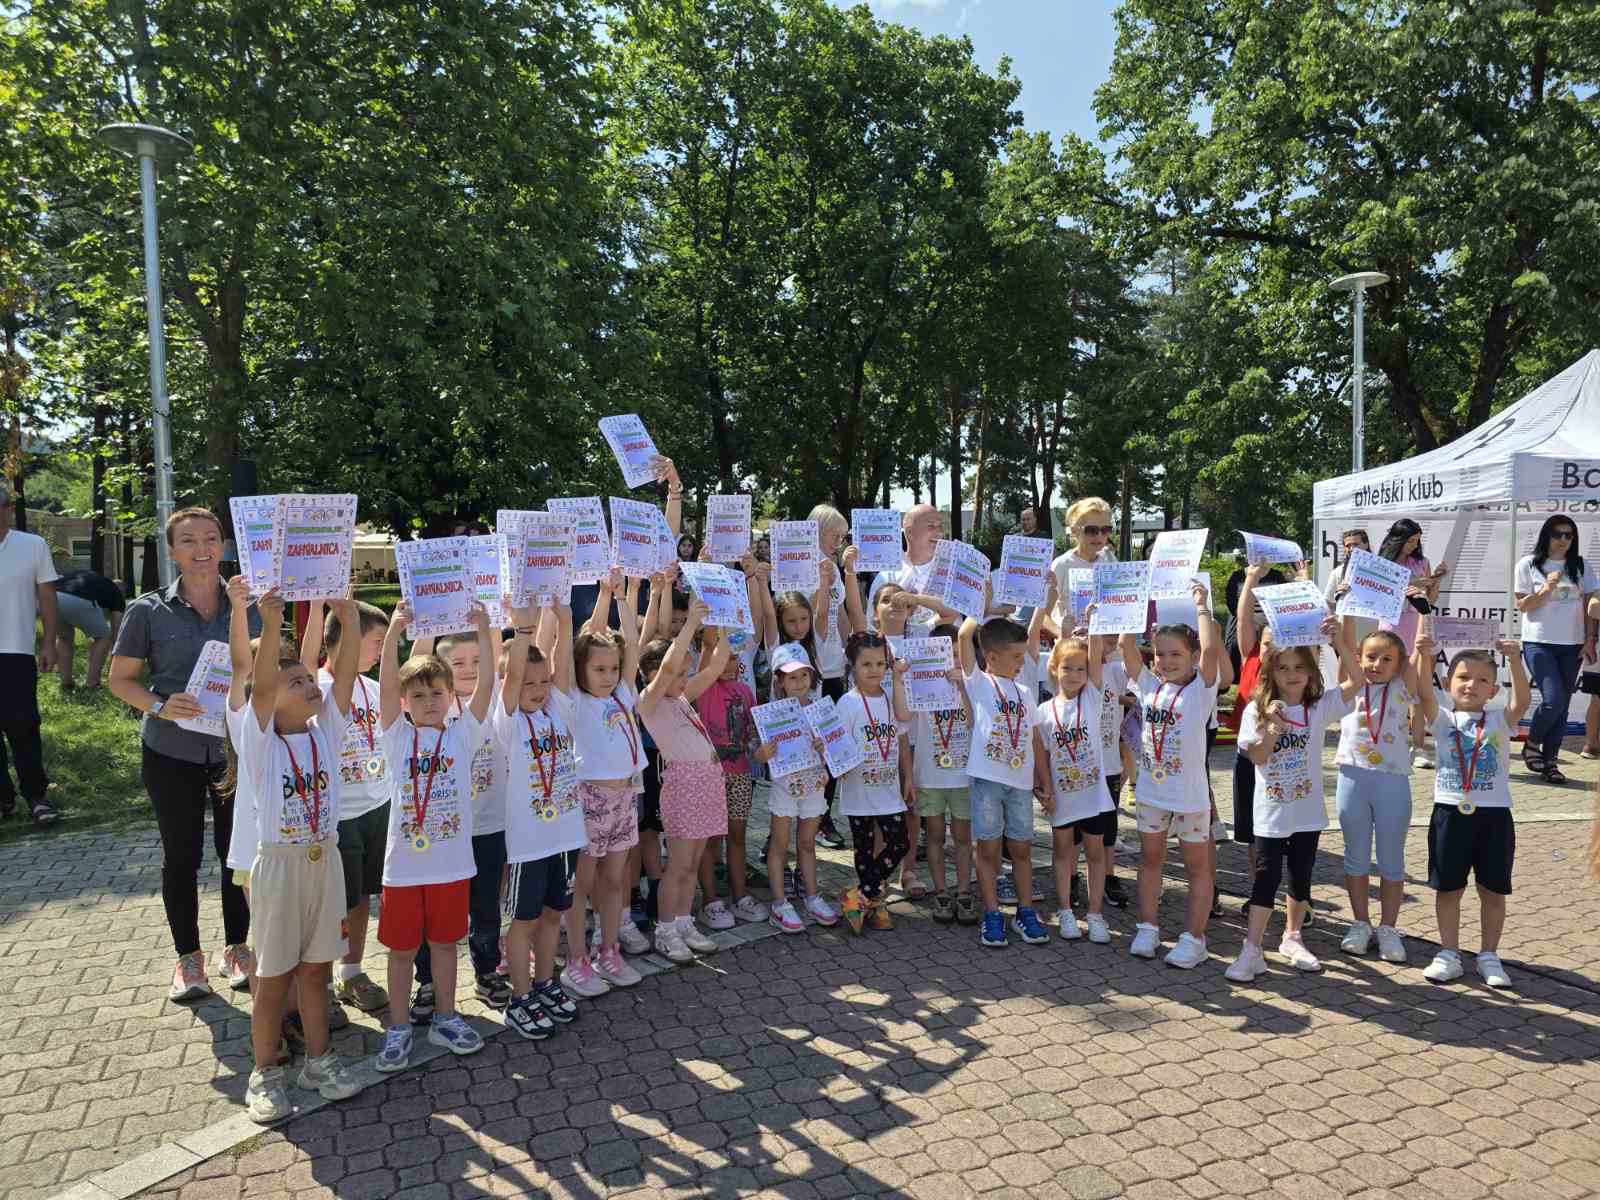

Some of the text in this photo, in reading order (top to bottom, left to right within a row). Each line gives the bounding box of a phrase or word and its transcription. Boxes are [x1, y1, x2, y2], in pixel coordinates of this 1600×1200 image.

[1354, 479, 1404, 507] atletski
[1408, 473, 1444, 501] klub
[287, 542, 340, 557] ZAHVALNICA
[414, 579, 465, 597] ZAHVALNICA
[1146, 705, 1176, 725] BORS
[409, 754, 448, 779] BOIS
